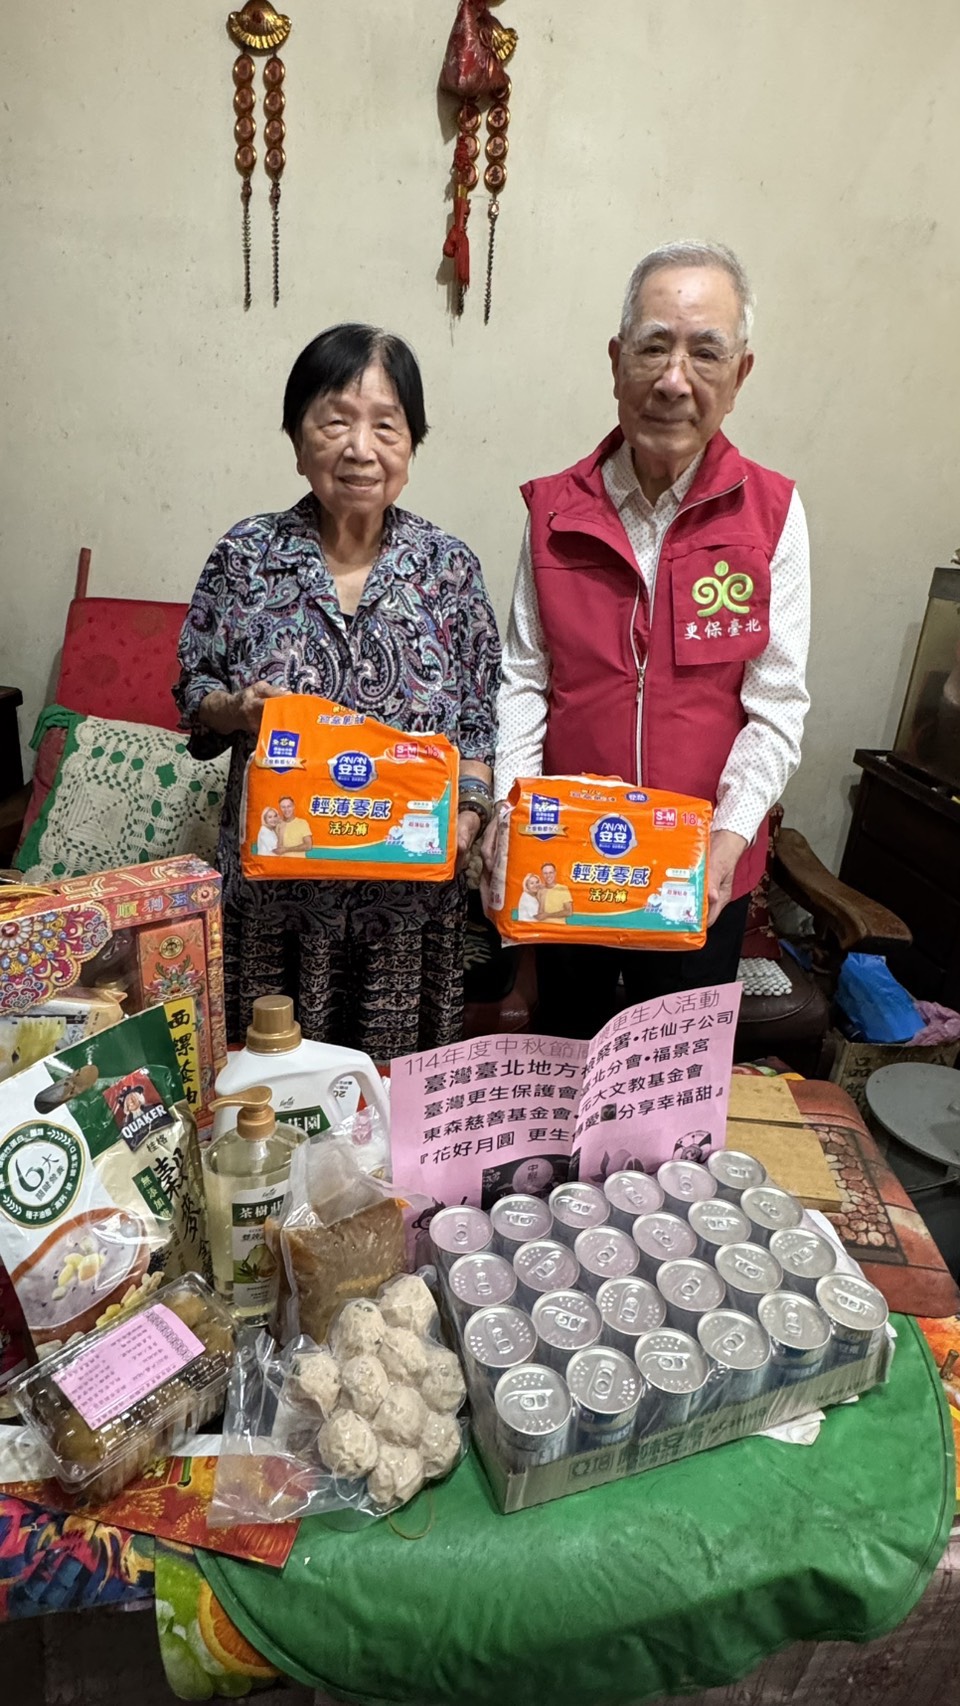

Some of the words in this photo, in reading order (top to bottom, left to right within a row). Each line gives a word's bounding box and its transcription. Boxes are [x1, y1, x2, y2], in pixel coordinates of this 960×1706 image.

[684, 618, 762, 640] 更保臺北
[338, 764, 367, 777] 安安
[310, 797, 391, 819] 輕薄零感
[655, 811, 676, 822] S-M
[329, 822, 369, 836] 活力褲
[599, 831, 627, 844] 安安
[572, 864, 650, 886] 輕薄零感
[589, 888, 628, 903] 活力褲
[121, 1104, 168, 1139] QUAKER
[146, 1134, 168, 1153] 桂格
